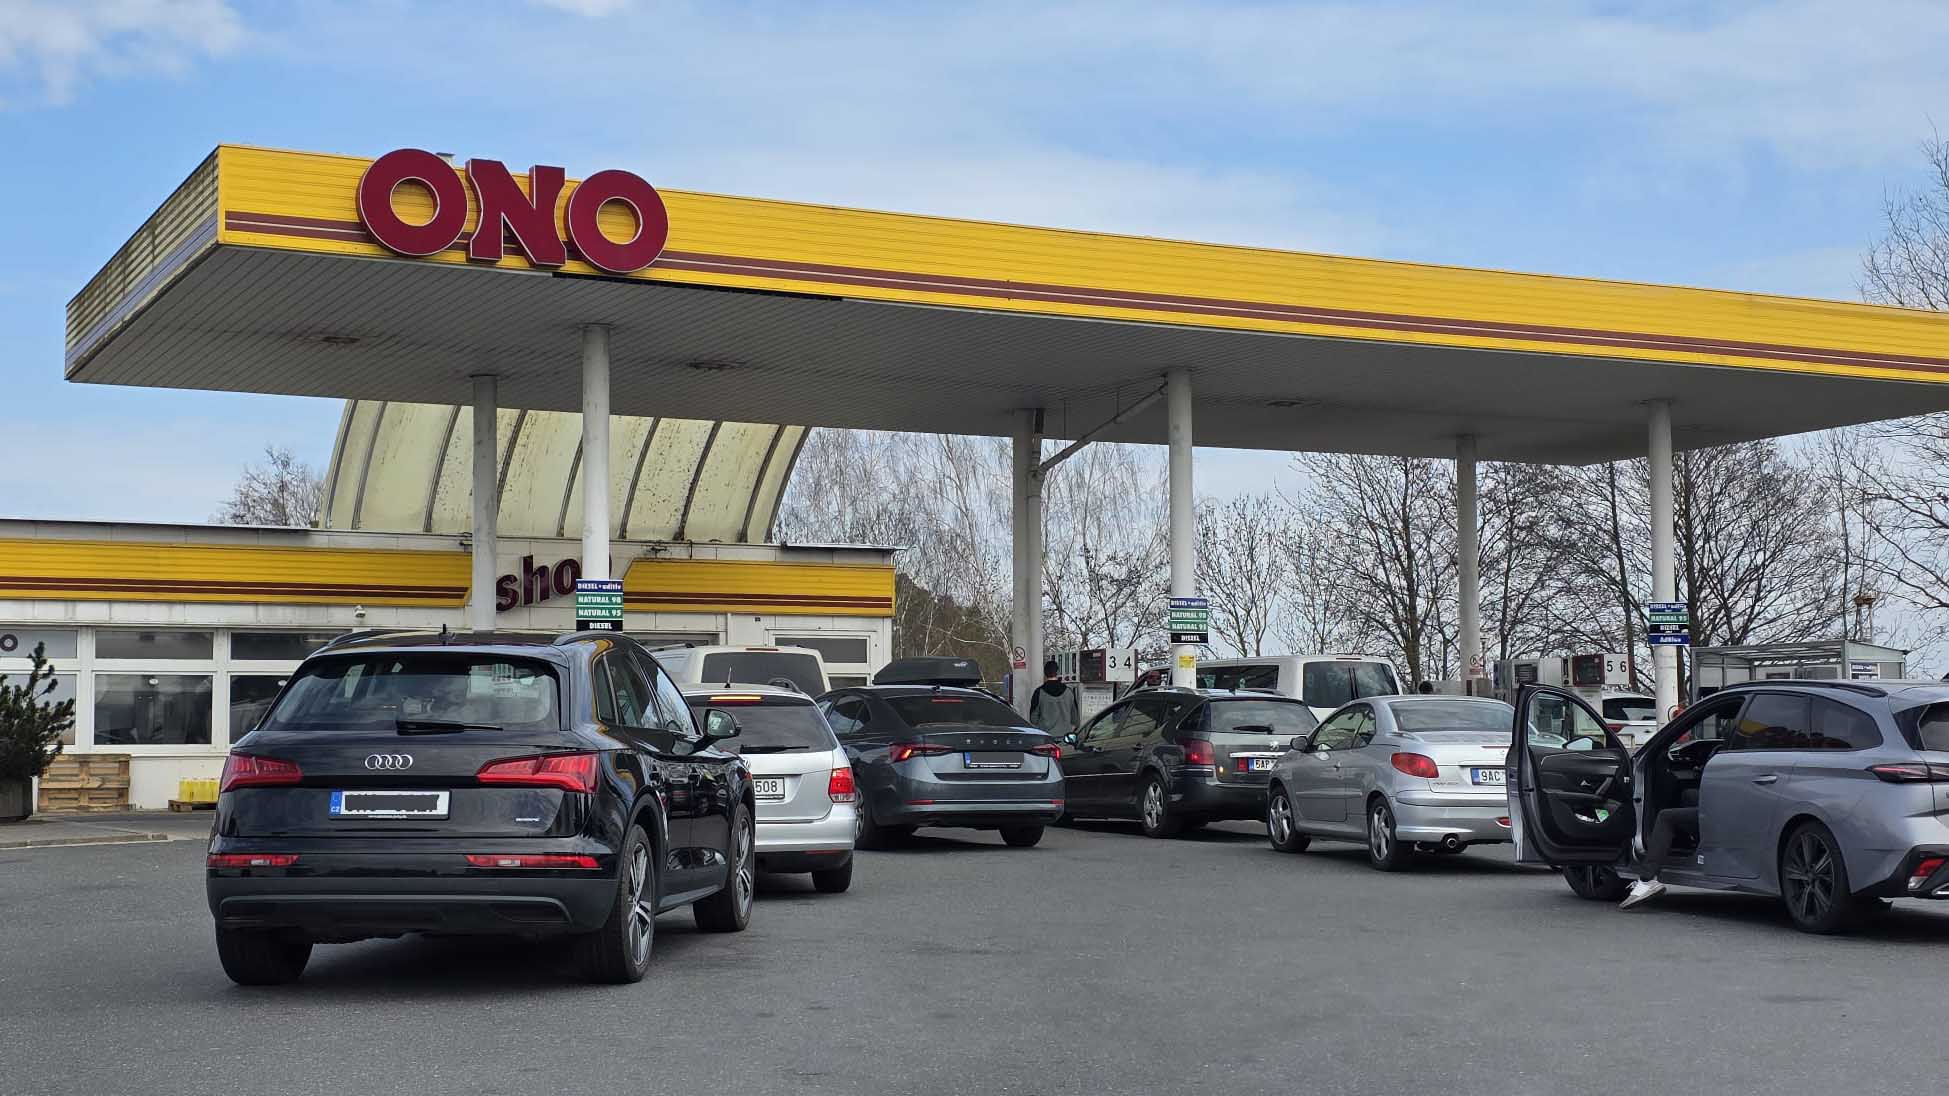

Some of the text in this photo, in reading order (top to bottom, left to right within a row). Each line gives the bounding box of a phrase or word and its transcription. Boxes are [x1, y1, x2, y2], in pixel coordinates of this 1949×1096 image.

[356, 148, 669, 275] ONO
[496, 554, 612, 611] sho
[611, 609, 622, 617] 95
[1108, 655, 1132, 669] 3 4
[1606, 660, 1627, 673] 5 6
